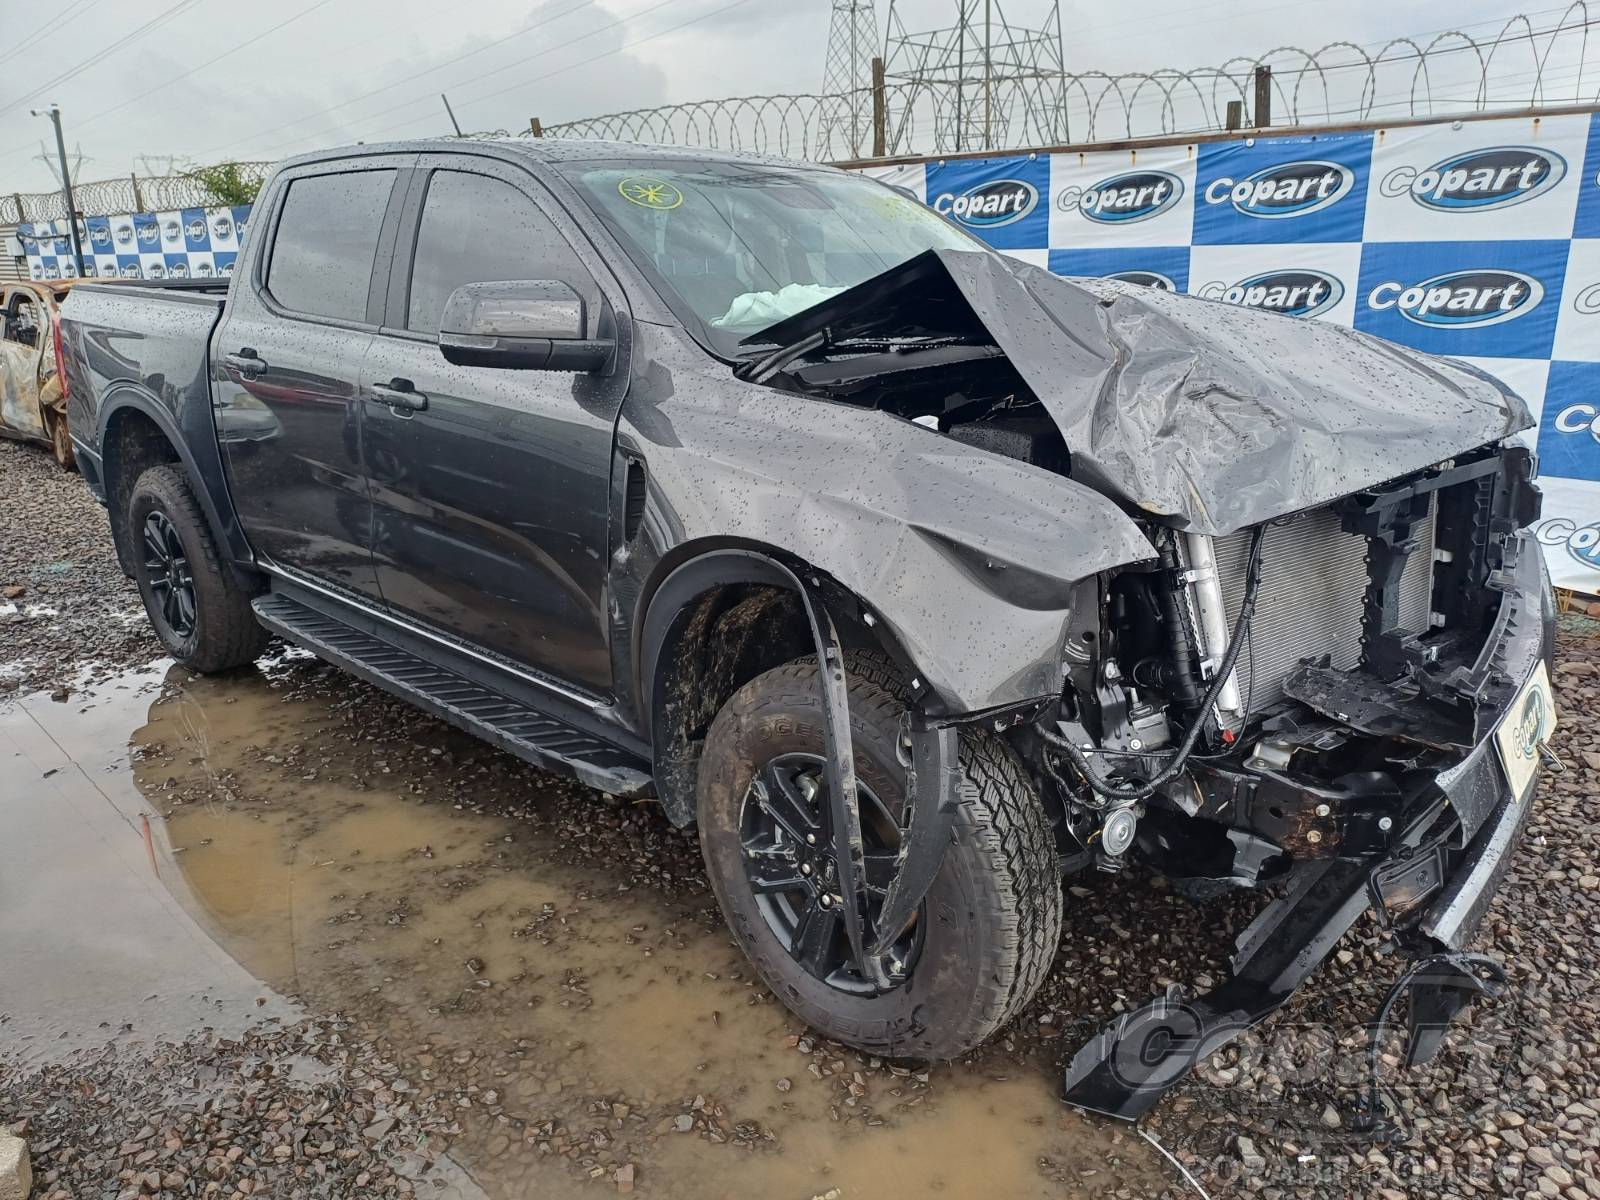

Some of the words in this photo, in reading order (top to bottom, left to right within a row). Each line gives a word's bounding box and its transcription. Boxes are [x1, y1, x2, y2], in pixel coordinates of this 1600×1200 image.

[1057, 180, 1167, 213] Copart
[1204, 169, 1336, 207] Copart
[1379, 158, 1541, 200] Copart
[934, 187, 1027, 218] Copart
[1367, 279, 1522, 316] Copart
[1513, 694, 1542, 759] Copart
